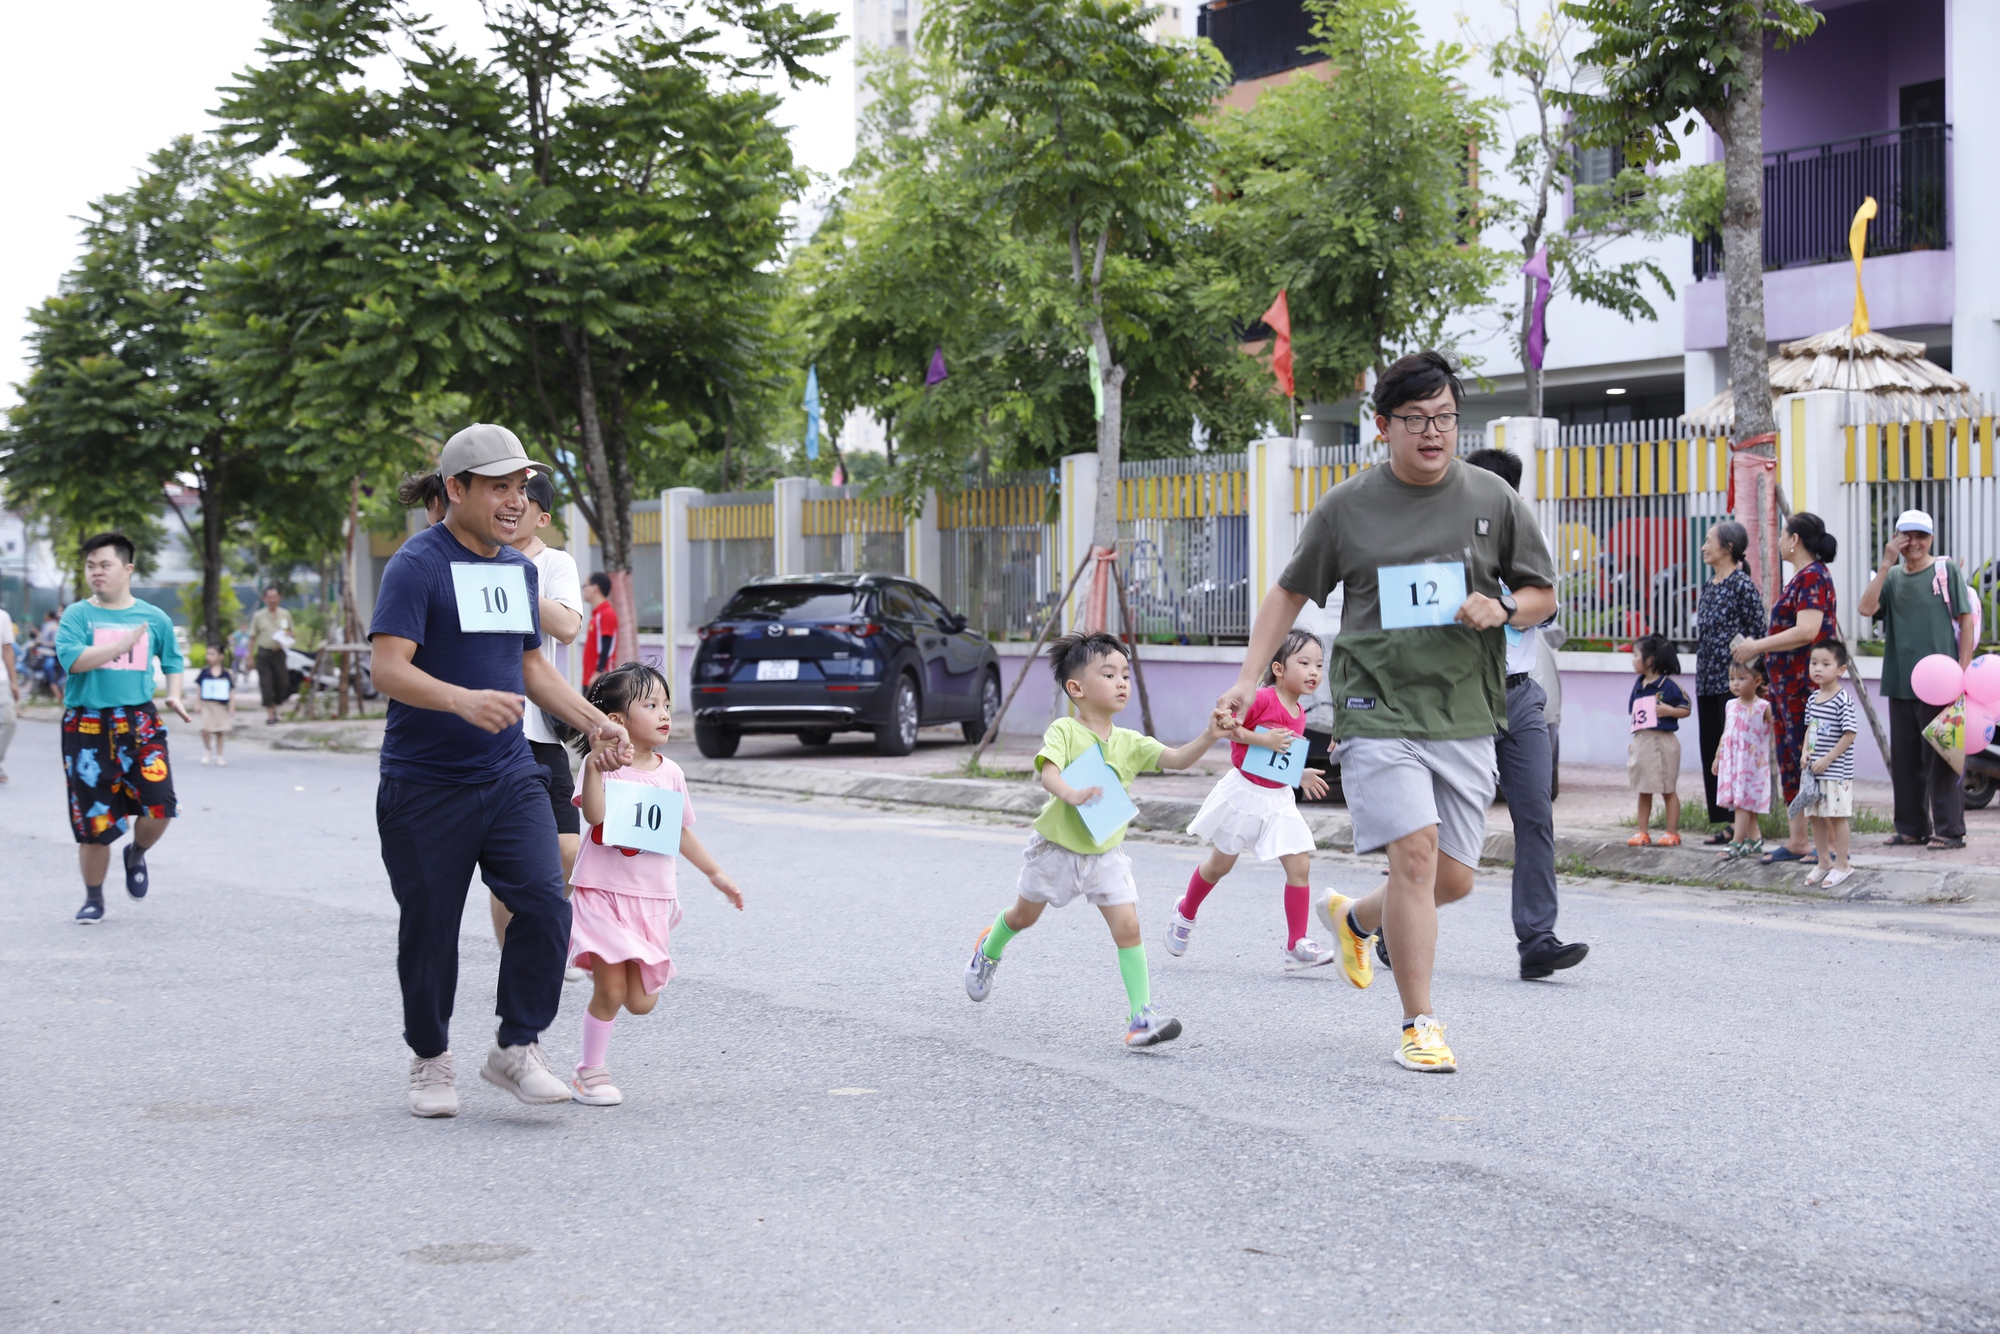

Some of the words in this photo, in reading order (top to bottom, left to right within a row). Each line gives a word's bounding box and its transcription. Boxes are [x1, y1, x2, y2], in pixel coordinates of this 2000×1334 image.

[480, 586, 509, 614] 10
[1407, 580, 1440, 607] 12
[1266, 750, 1292, 771] 15
[632, 801, 662, 832] 10
